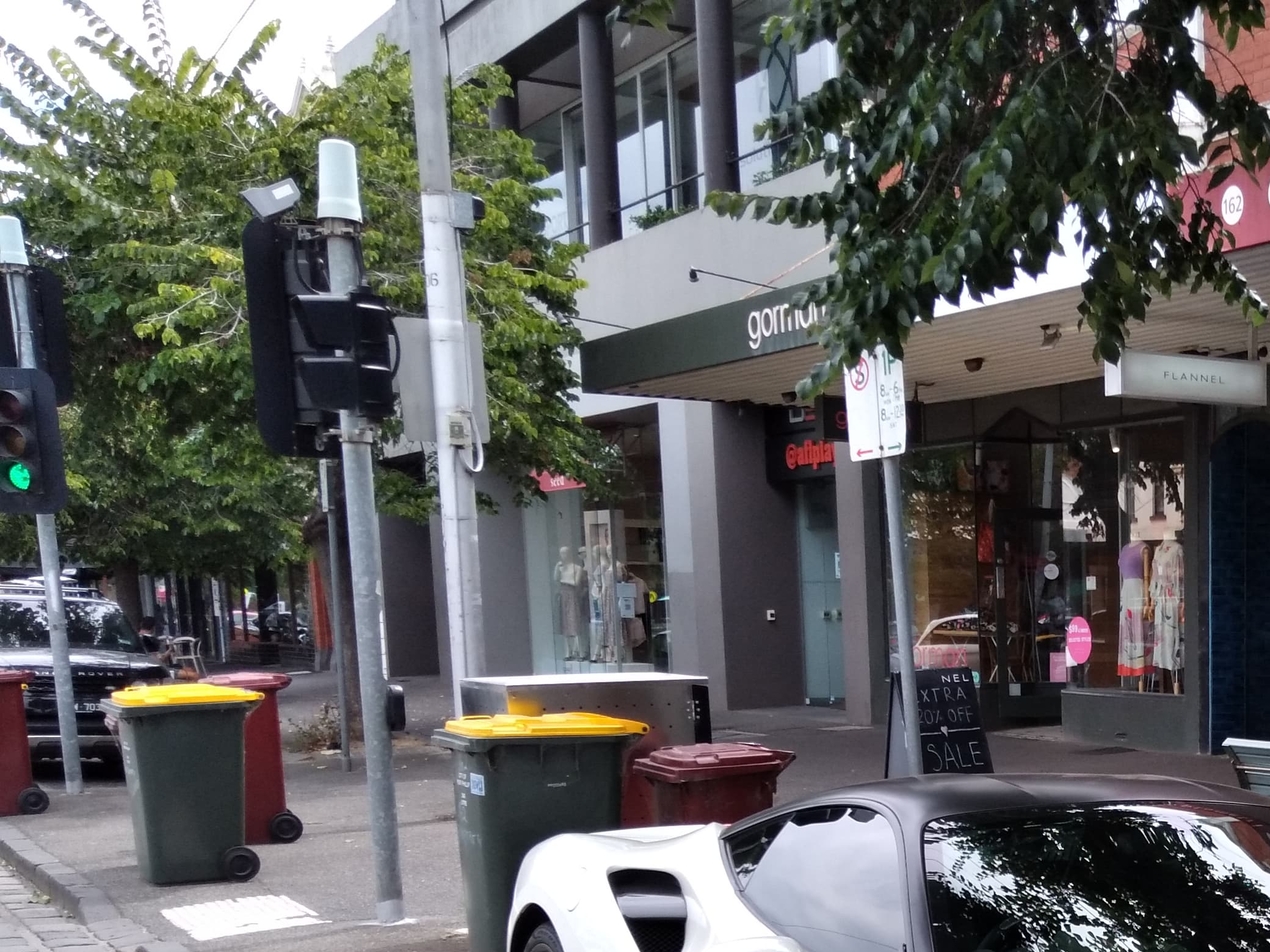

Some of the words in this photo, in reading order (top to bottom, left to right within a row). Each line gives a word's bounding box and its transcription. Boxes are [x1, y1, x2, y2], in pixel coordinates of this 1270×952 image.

[1223, 195, 1243, 216] 162
[1163, 371, 1226, 384] FLANNEL
[917, 686, 967, 703] XTRA
[947, 706, 974, 723] OFF
[926, 741, 985, 772] SALE
